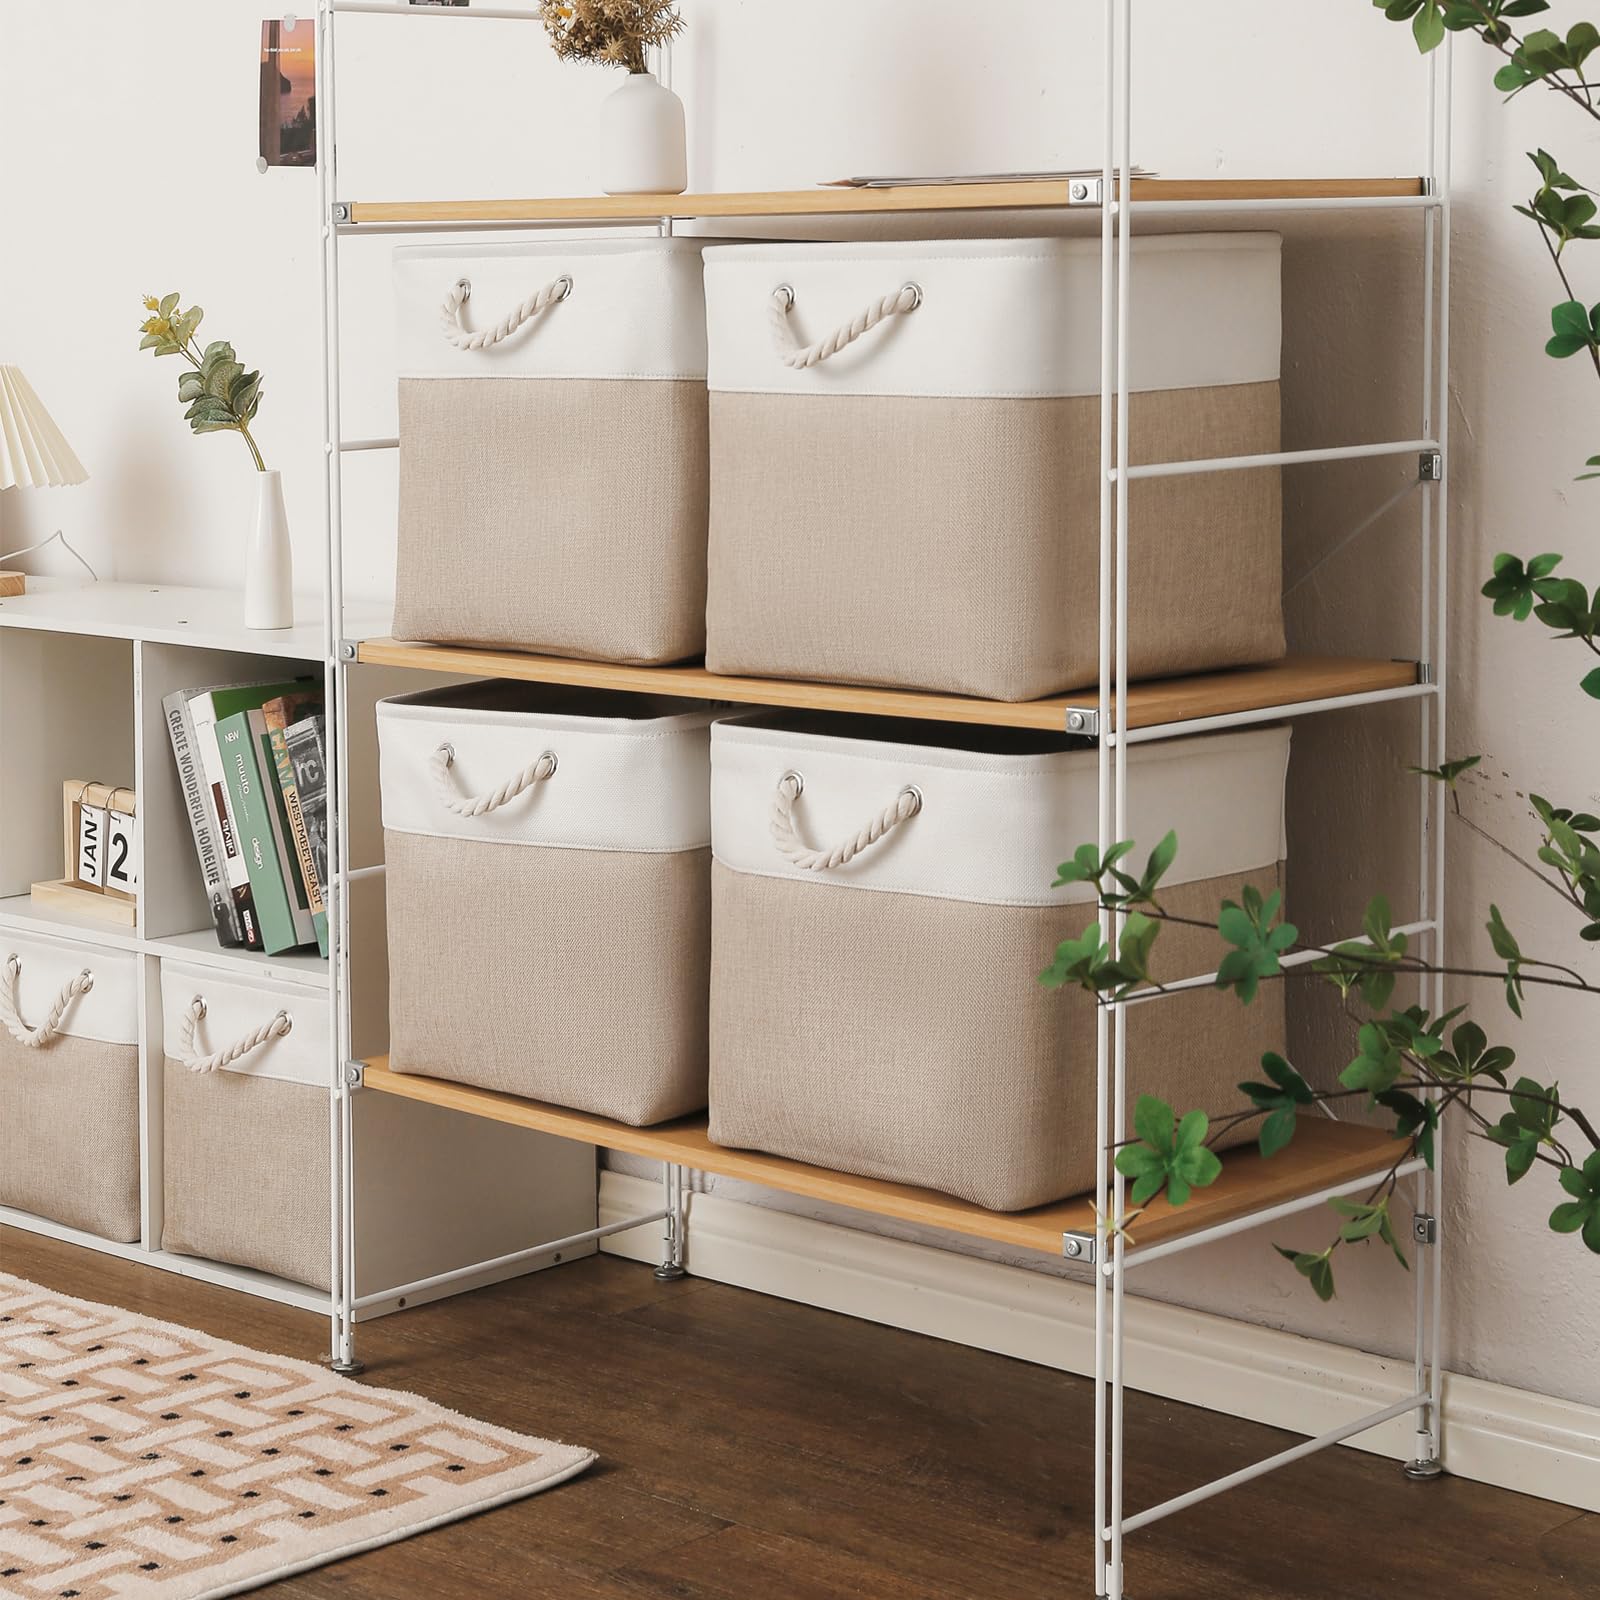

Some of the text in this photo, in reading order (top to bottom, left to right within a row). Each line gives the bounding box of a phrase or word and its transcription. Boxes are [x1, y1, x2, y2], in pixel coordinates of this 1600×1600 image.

[224, 730, 239, 743] NEW
[235, 753, 250, 794] muuto
[169, 709, 188, 752] CREATE
[180, 752, 206, 826] WONDERFUL
[197, 827, 220, 886] HOMELIFE
[84, 820, 97, 878] JAN
[110, 832, 137, 884] 2
[222, 818, 235, 855] olivia
[252, 837, 264, 870] design
[288, 791, 323, 905] WESTMEETSEAST
